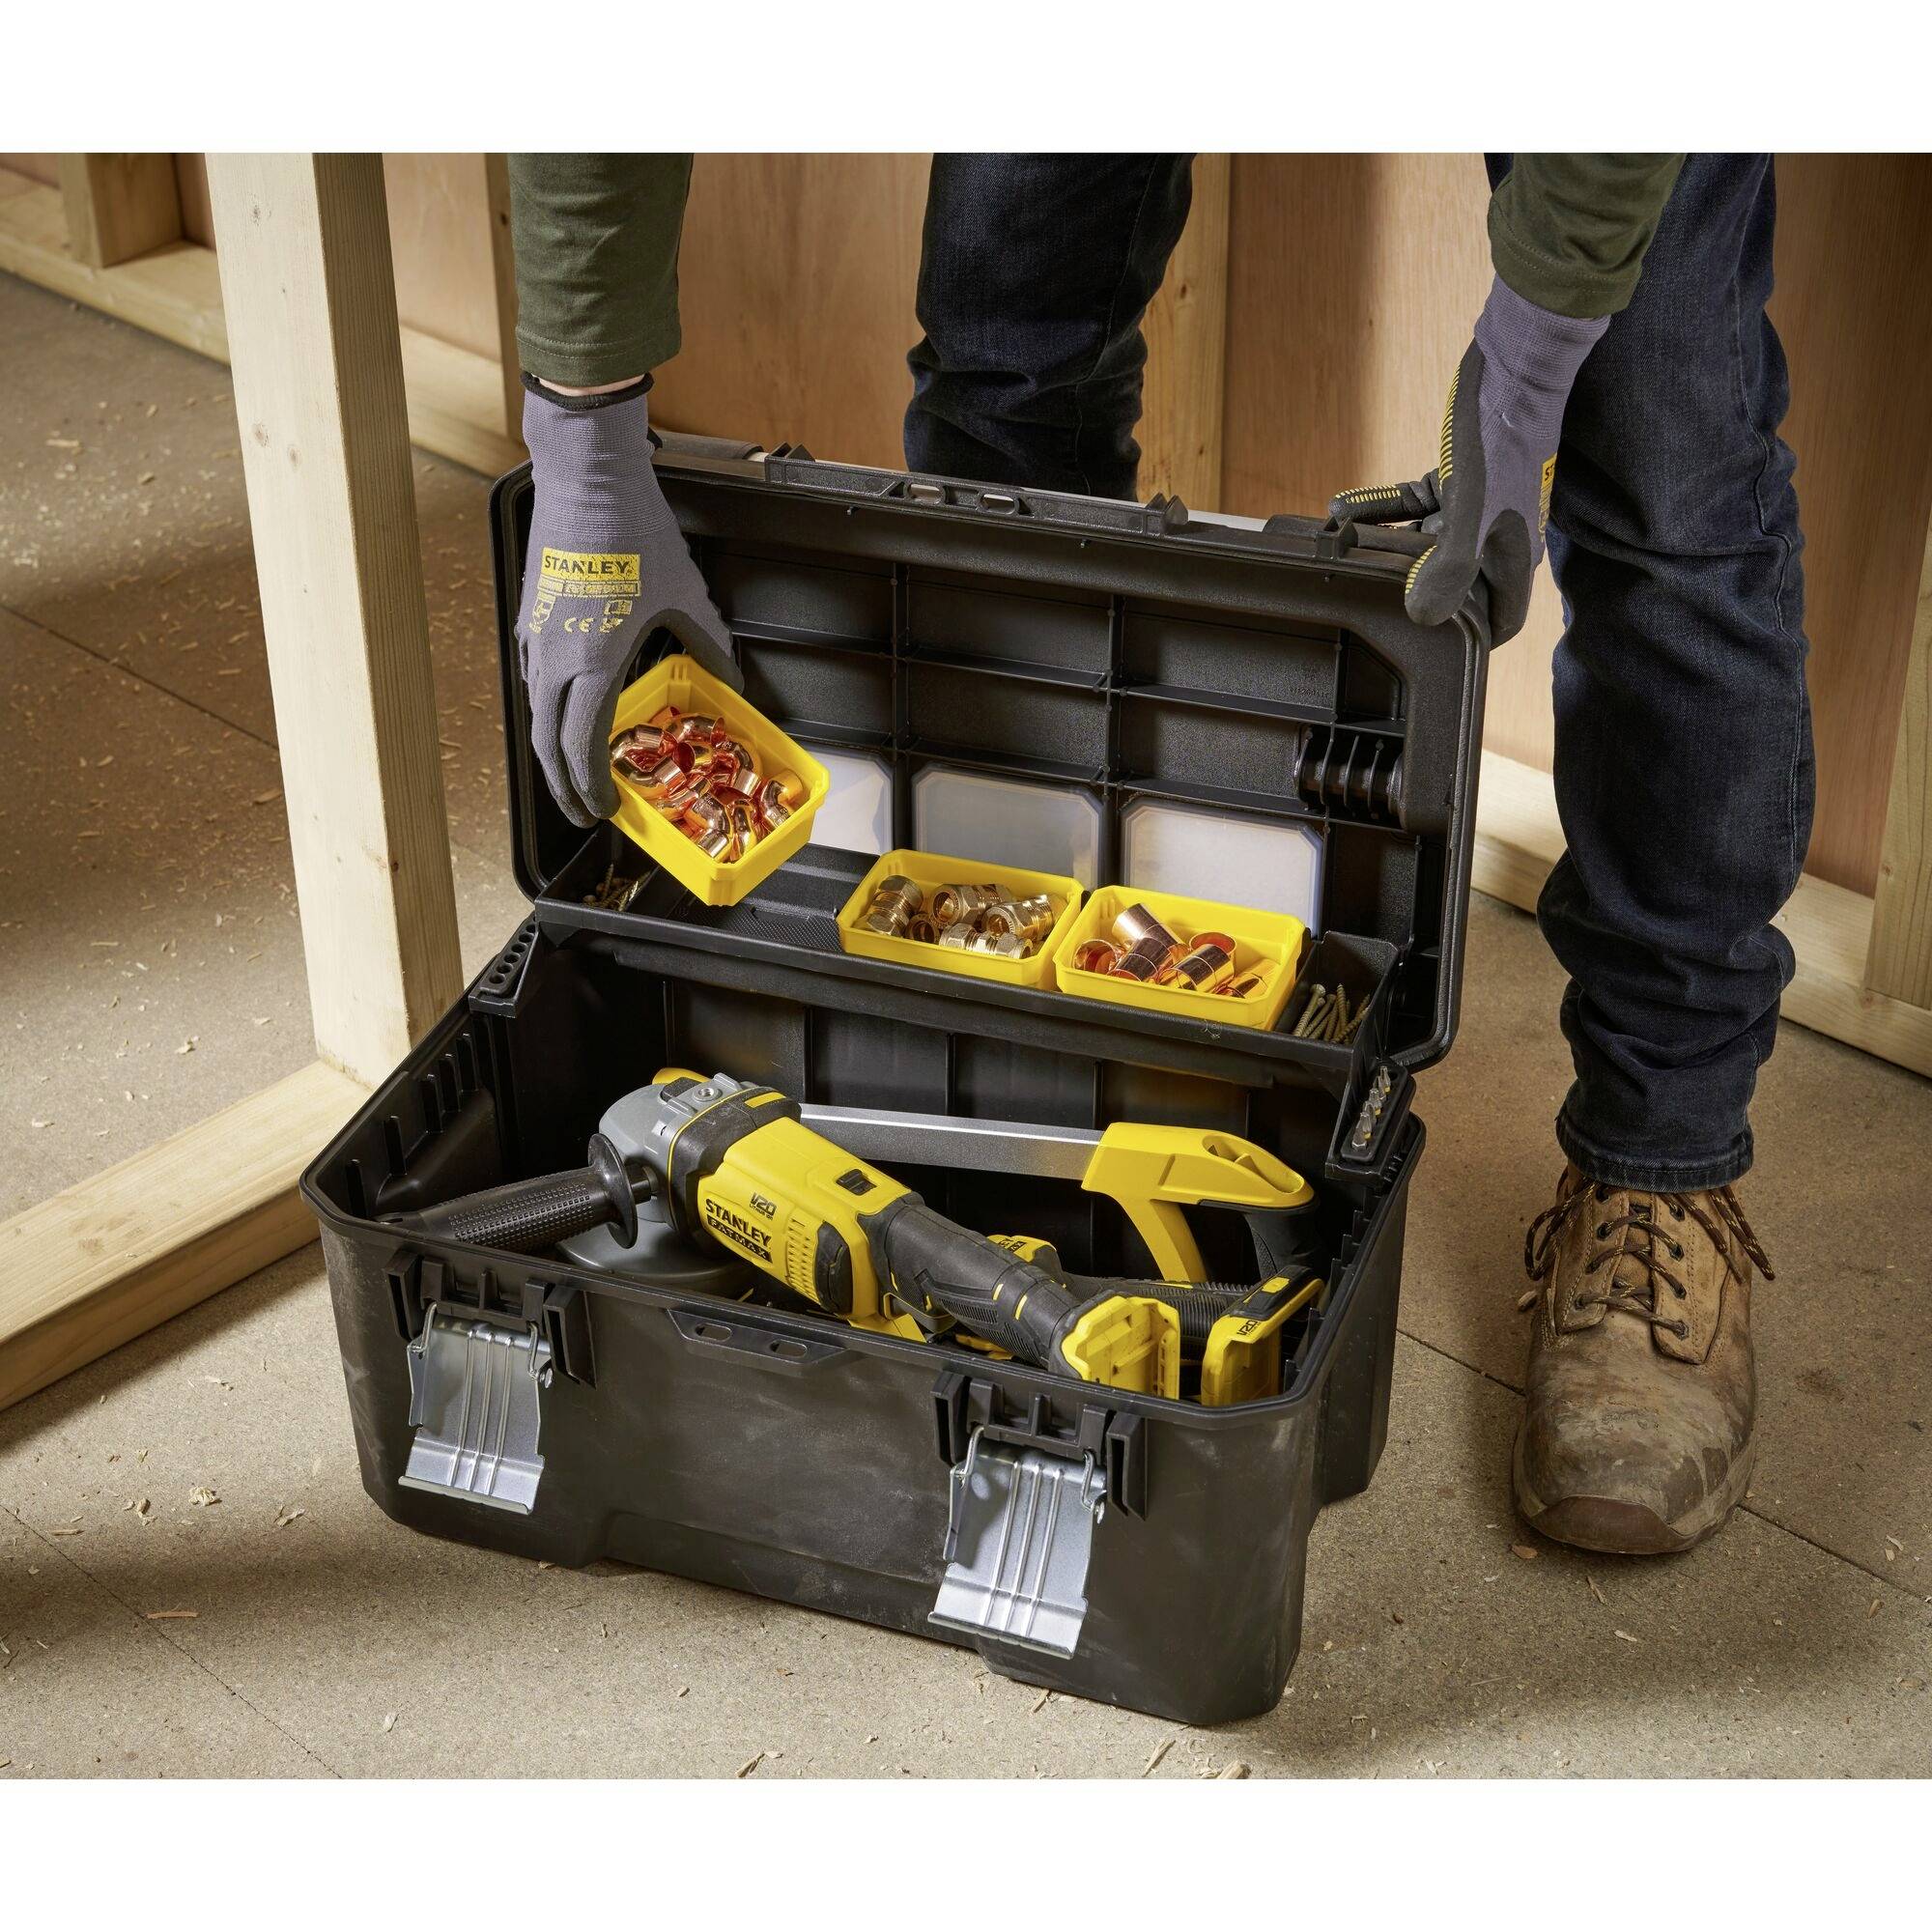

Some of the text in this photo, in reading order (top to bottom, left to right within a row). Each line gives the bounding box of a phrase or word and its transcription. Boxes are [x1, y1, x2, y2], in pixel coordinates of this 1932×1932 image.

[545, 555, 630, 575] STANLEY
[751, 1191, 777, 1216] V20
[705, 1198, 772, 1247] STANLEY
[711, 1219, 767, 1259] FATMAX
